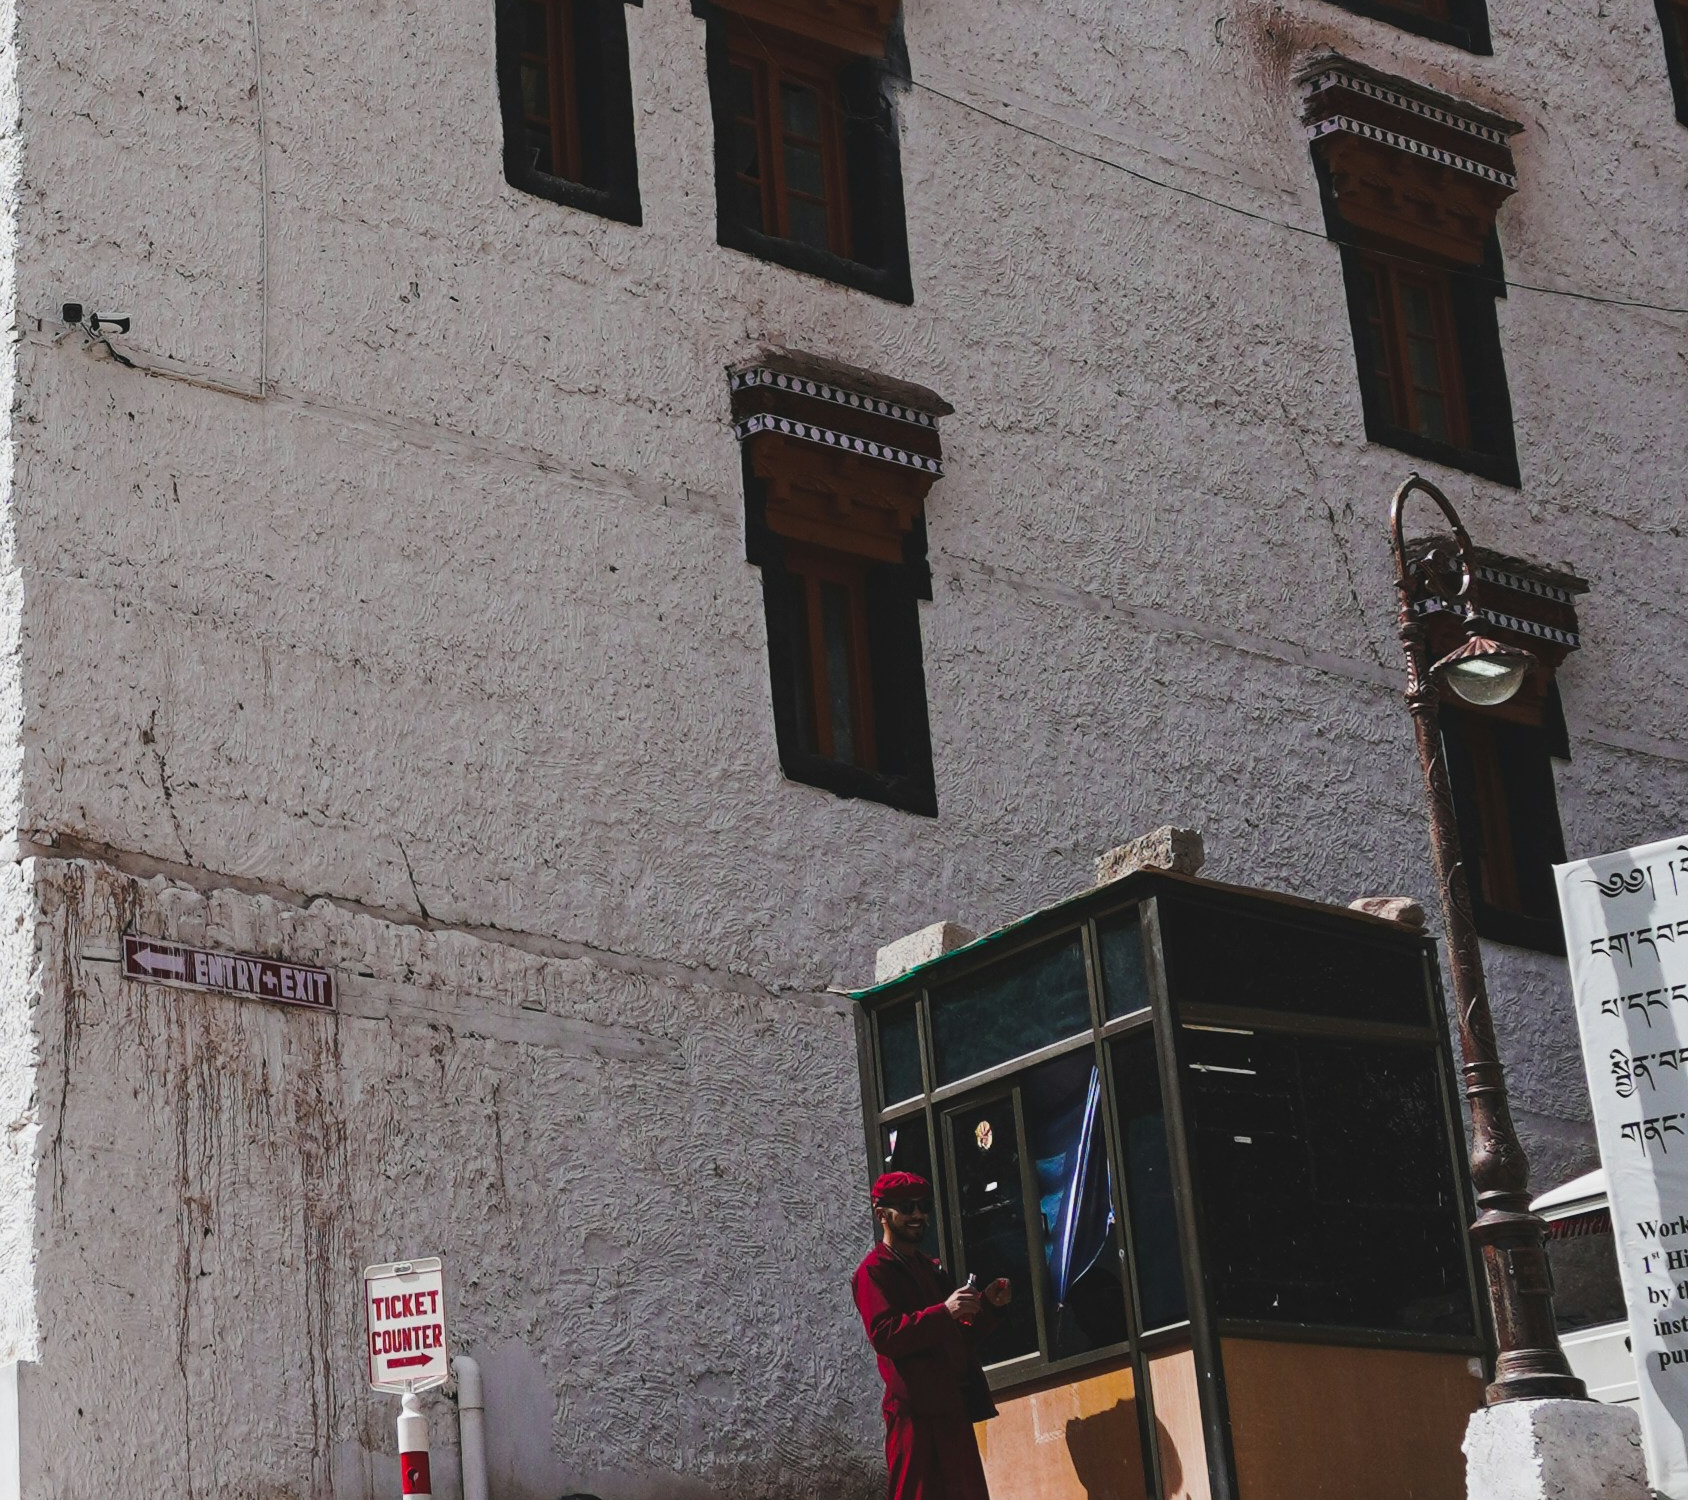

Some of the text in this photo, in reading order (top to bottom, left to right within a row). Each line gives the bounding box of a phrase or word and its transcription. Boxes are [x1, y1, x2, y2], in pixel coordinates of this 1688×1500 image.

[372, 1289, 439, 1322] TICKET
[1647, 1286, 1672, 1308] by
[371, 1323, 443, 1356] COUNTER
